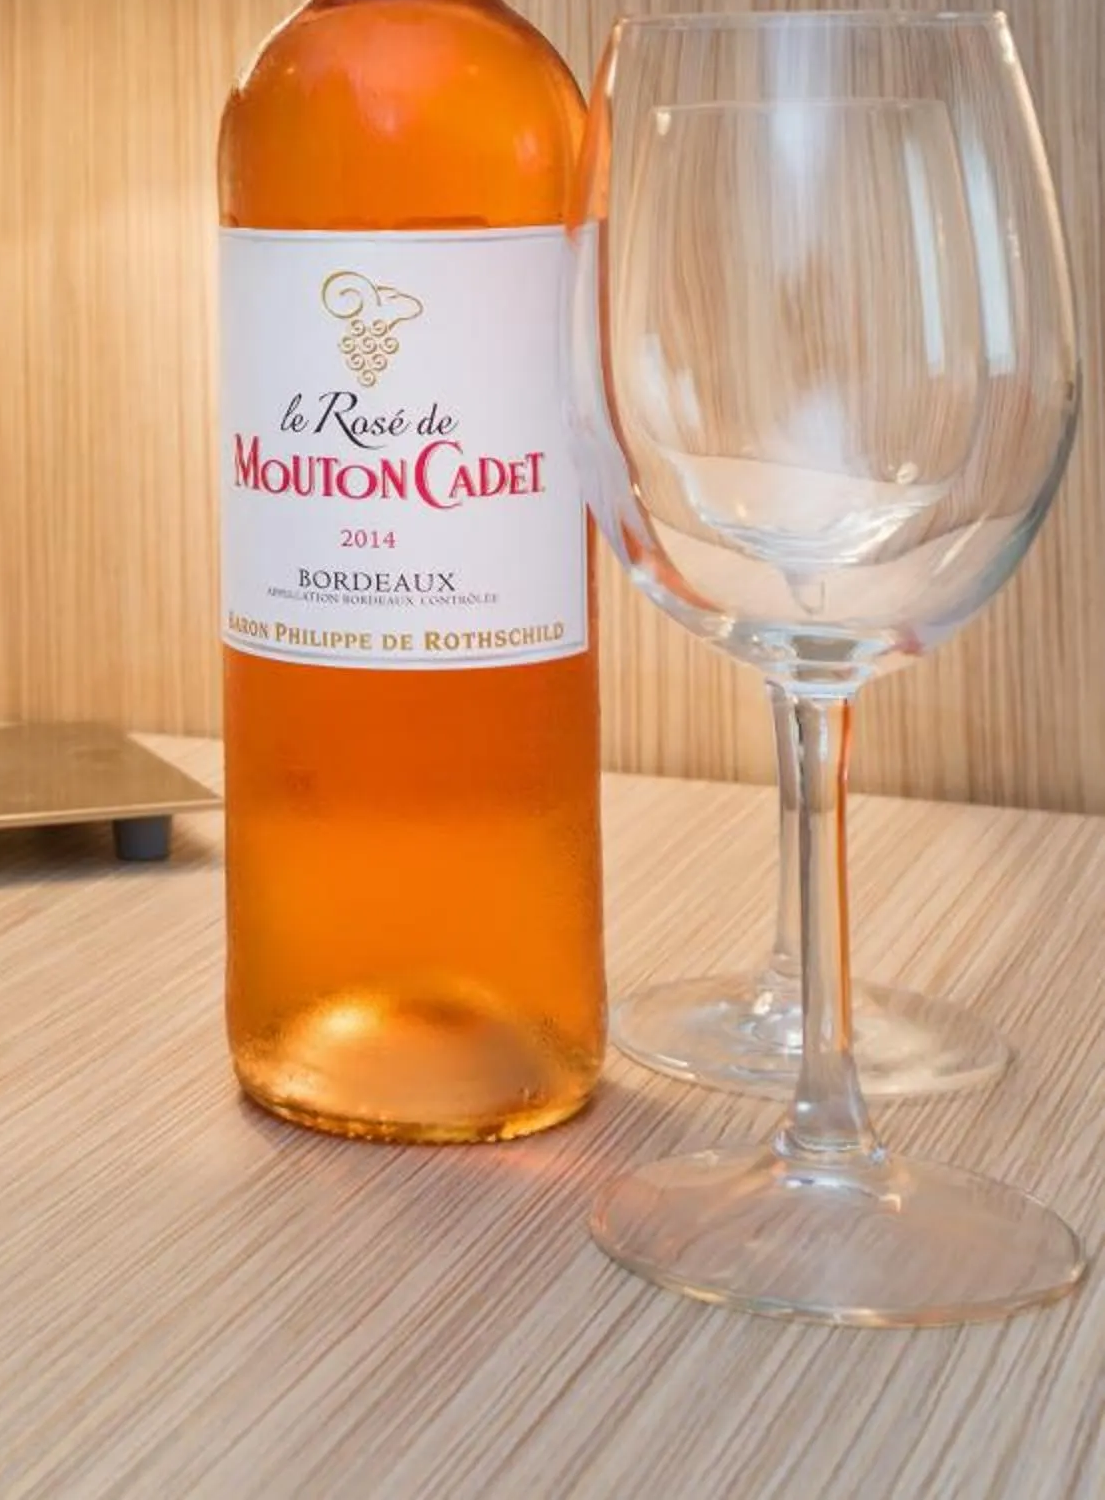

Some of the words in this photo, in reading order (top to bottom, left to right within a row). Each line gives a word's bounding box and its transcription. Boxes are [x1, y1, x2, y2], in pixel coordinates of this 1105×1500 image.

[280, 393, 309, 433] le
[314, 391, 409, 450] Rosé
[417, 403, 458, 436] de
[233, 433, 407, 499] MOUTON
[414, 440, 545, 509] CADET
[340, 529, 395, 549] 2014
[298, 568, 456, 593] BORDEAUX
[275, 622, 373, 649] PHILIPPE
[382, 633, 413, 650] DE
[424, 622, 564, 651] ROTHSCHILD
